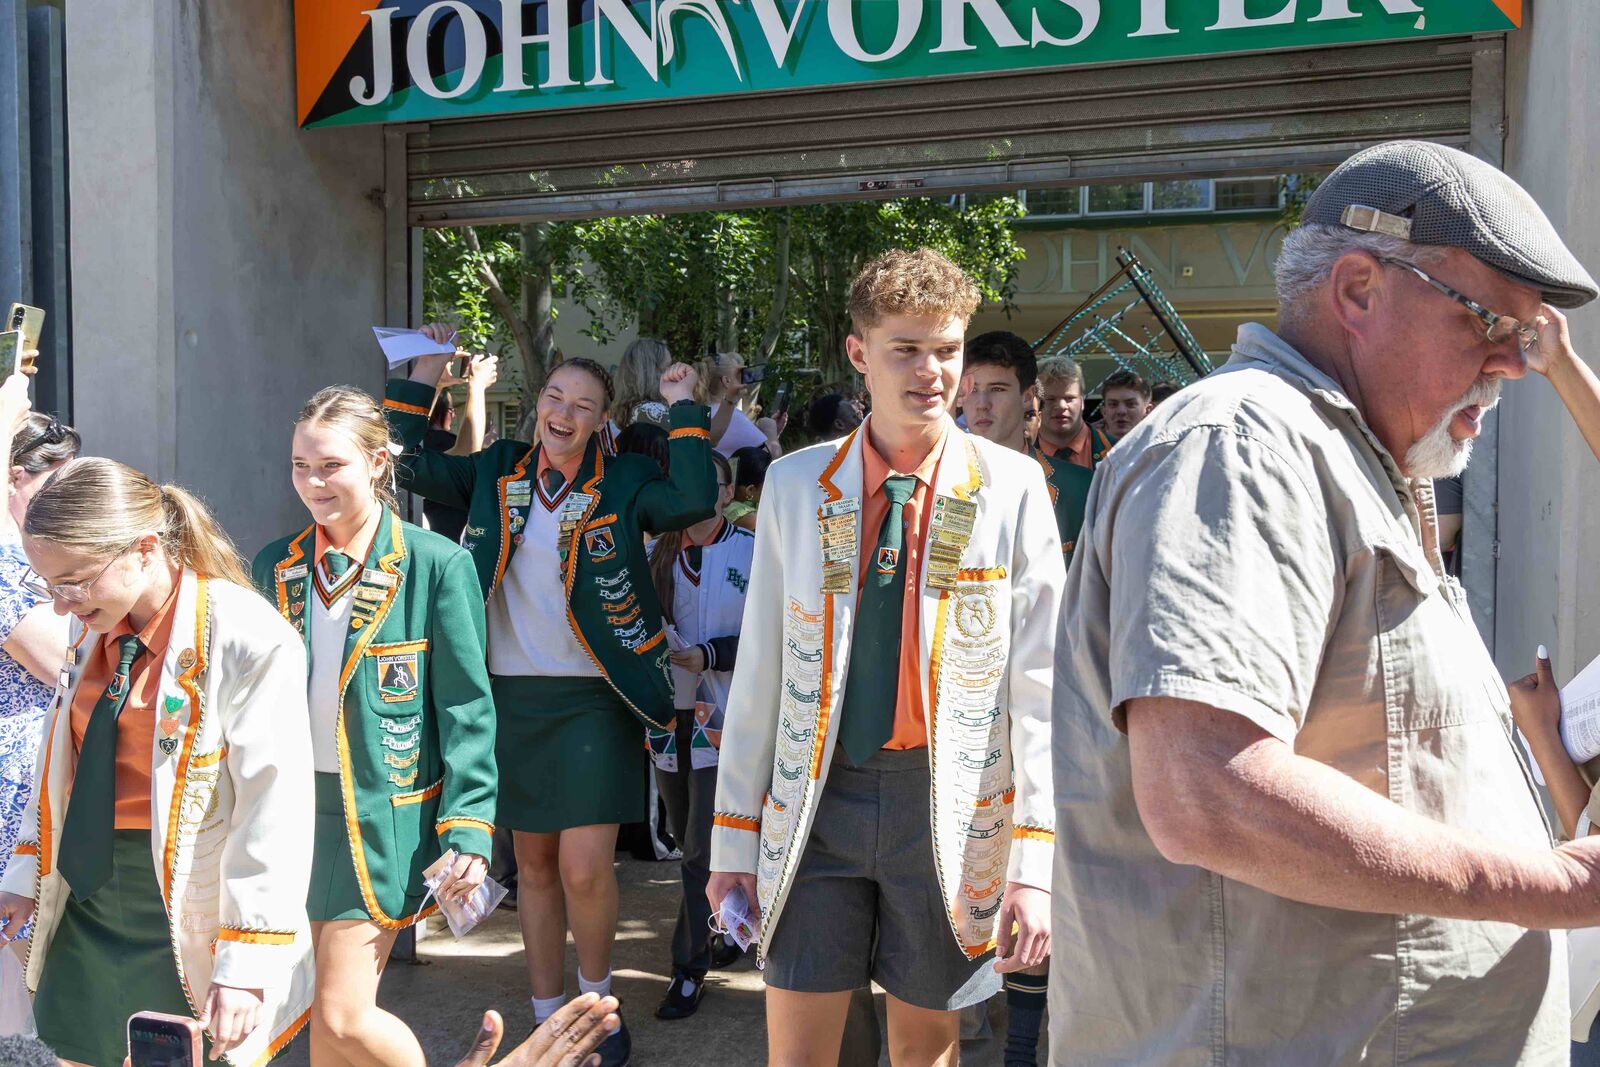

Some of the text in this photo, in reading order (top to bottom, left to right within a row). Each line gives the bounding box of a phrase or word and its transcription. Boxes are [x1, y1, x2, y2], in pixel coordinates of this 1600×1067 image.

[349, 0, 1425, 106] JOHN VORS
[1018, 228, 1184, 294] OHN
